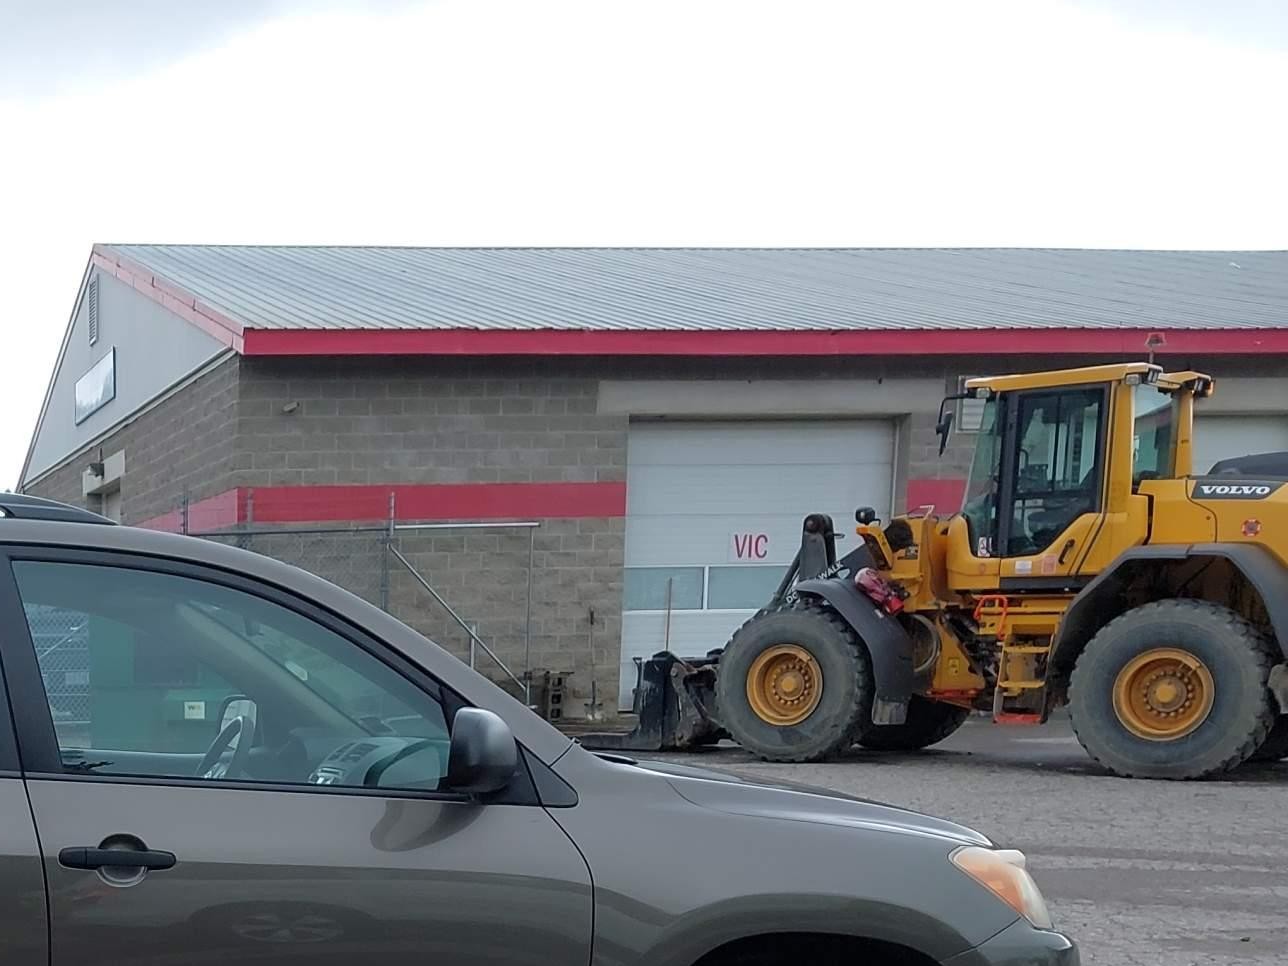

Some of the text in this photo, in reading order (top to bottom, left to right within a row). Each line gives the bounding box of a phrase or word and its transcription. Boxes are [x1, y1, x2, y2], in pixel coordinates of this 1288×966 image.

[1199, 485, 1271, 495] VOLVO
[734, 533, 768, 559] VIC
[817, 560, 844, 580] WALK
